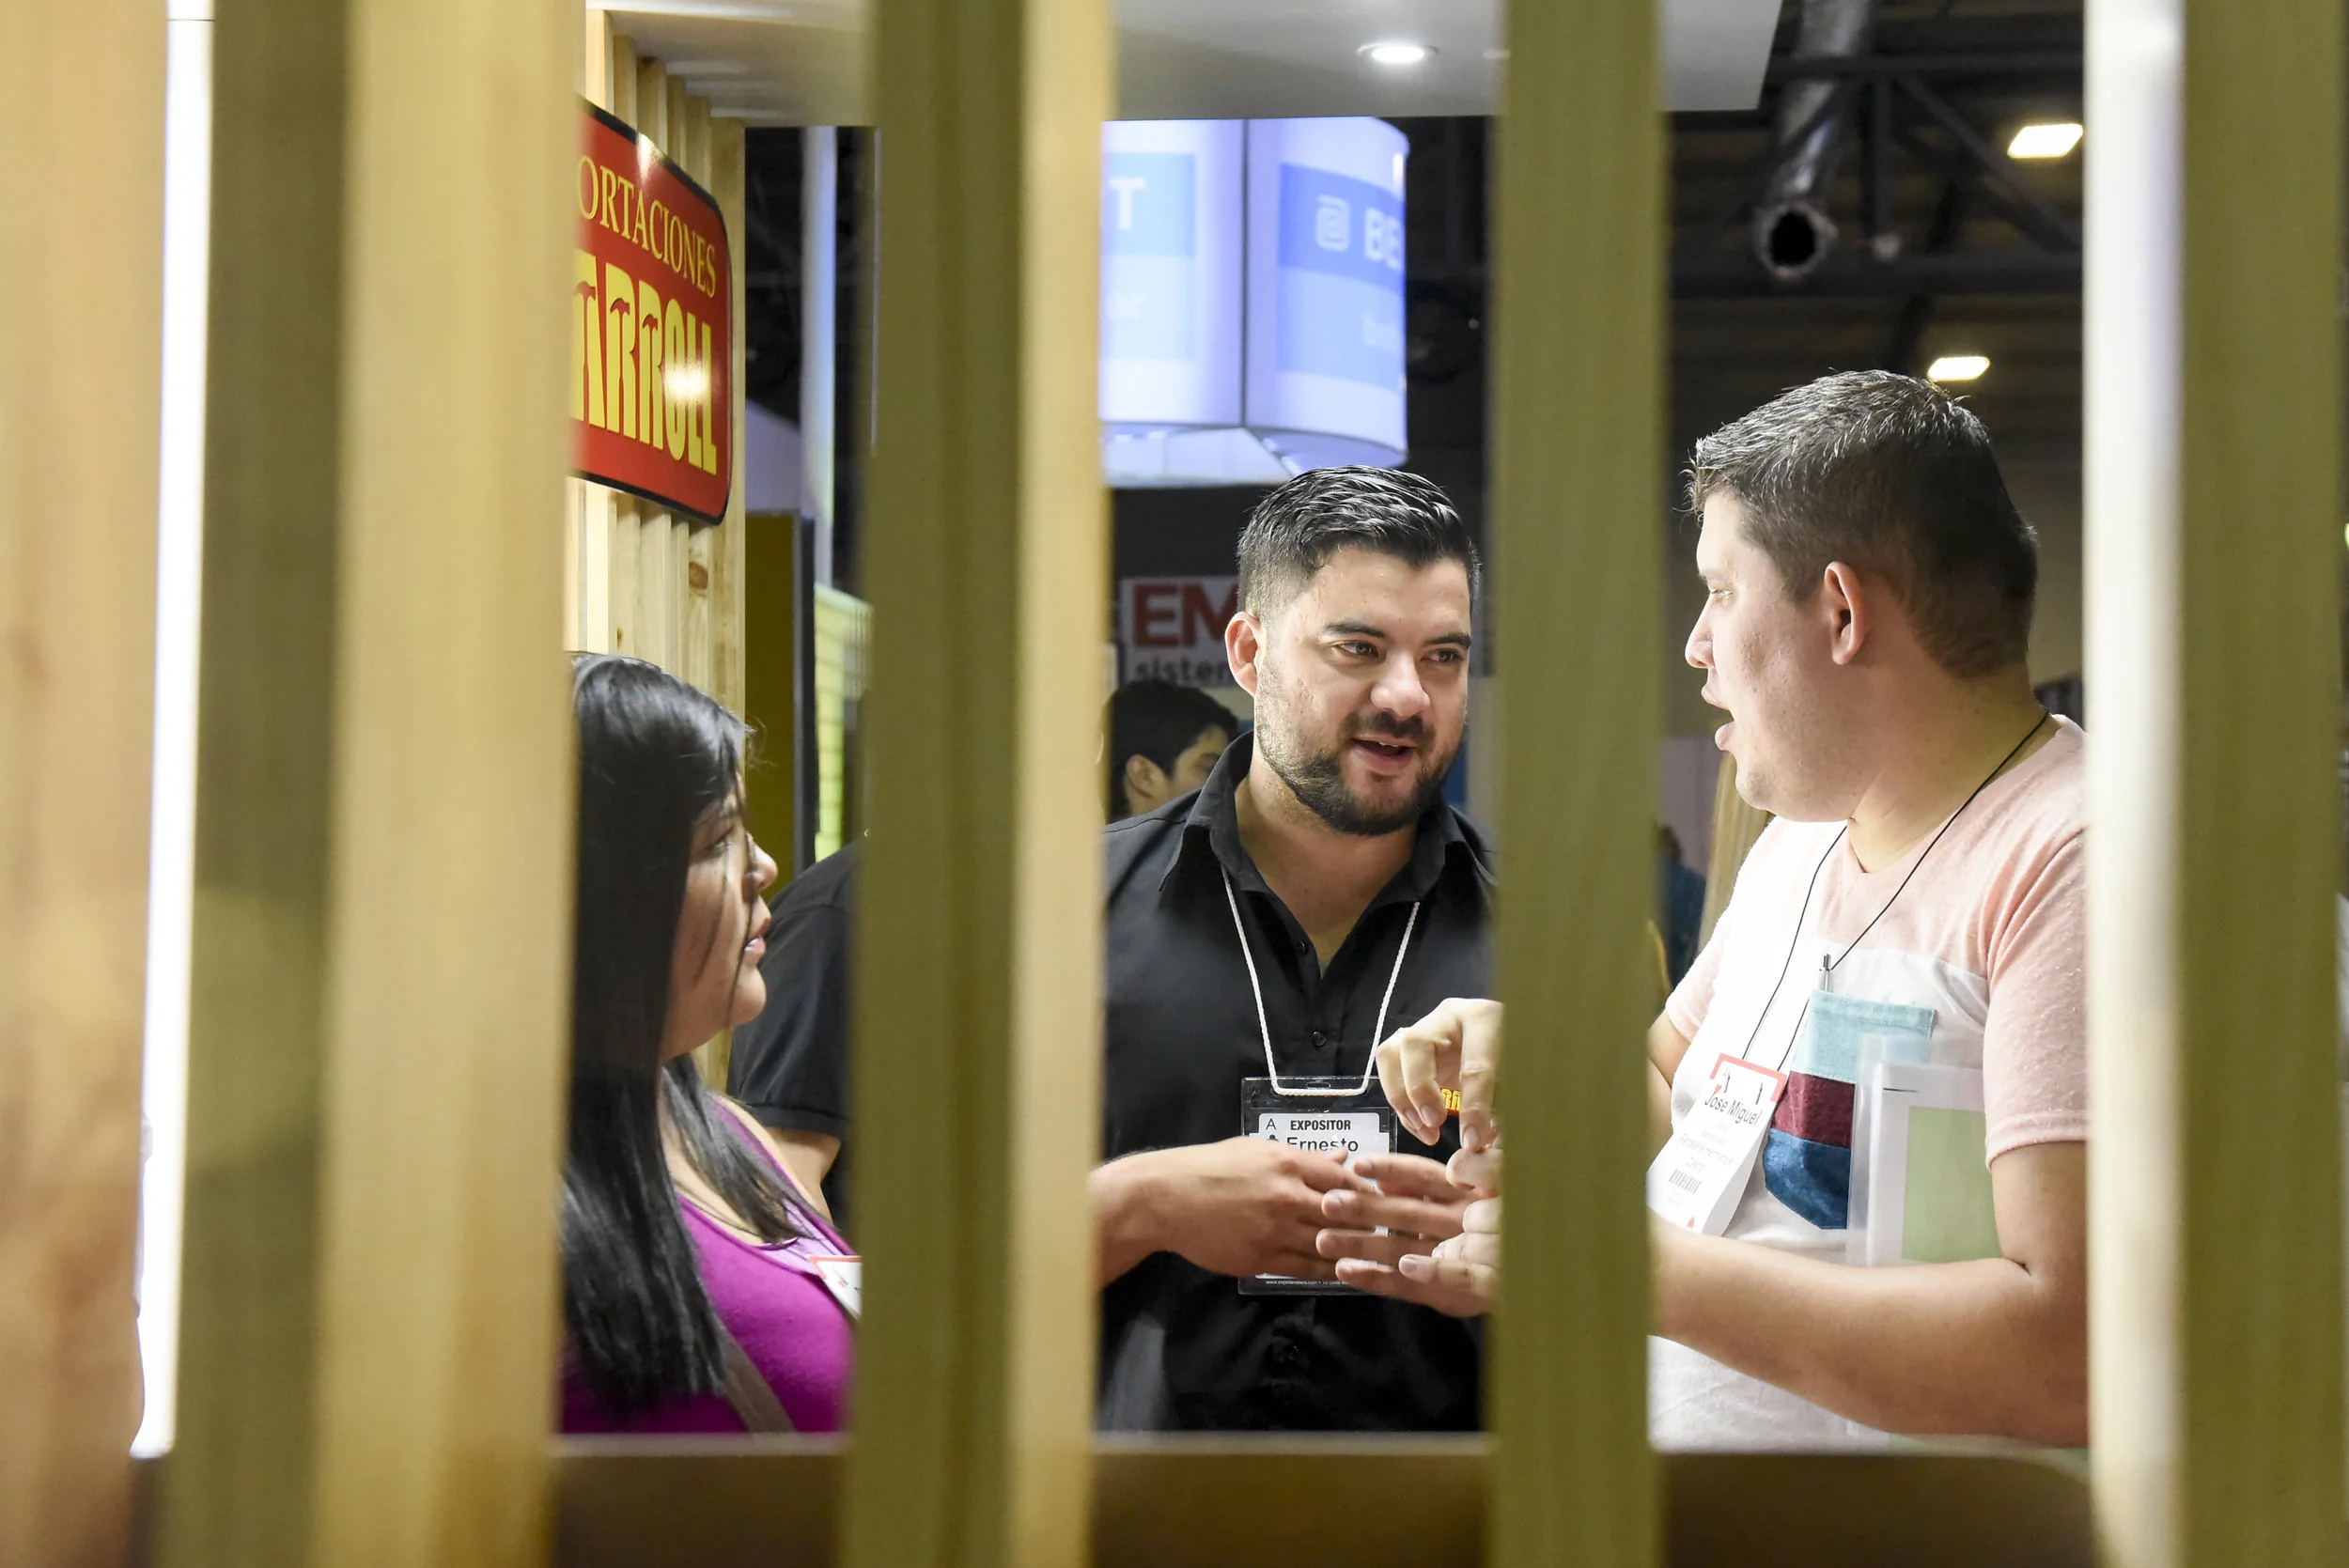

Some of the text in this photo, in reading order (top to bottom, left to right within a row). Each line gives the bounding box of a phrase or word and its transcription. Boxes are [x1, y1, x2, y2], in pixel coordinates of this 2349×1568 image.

[576, 154, 716, 299] ORTACIONES
[1704, 1091, 1729, 1113] Jose
[1727, 1099, 1763, 1126] Miguel
[1265, 1118, 1277, 1130] A
[1290, 1120, 1351, 1130] EXPOSITOR
[1286, 1136, 1359, 1152] Ernesto
